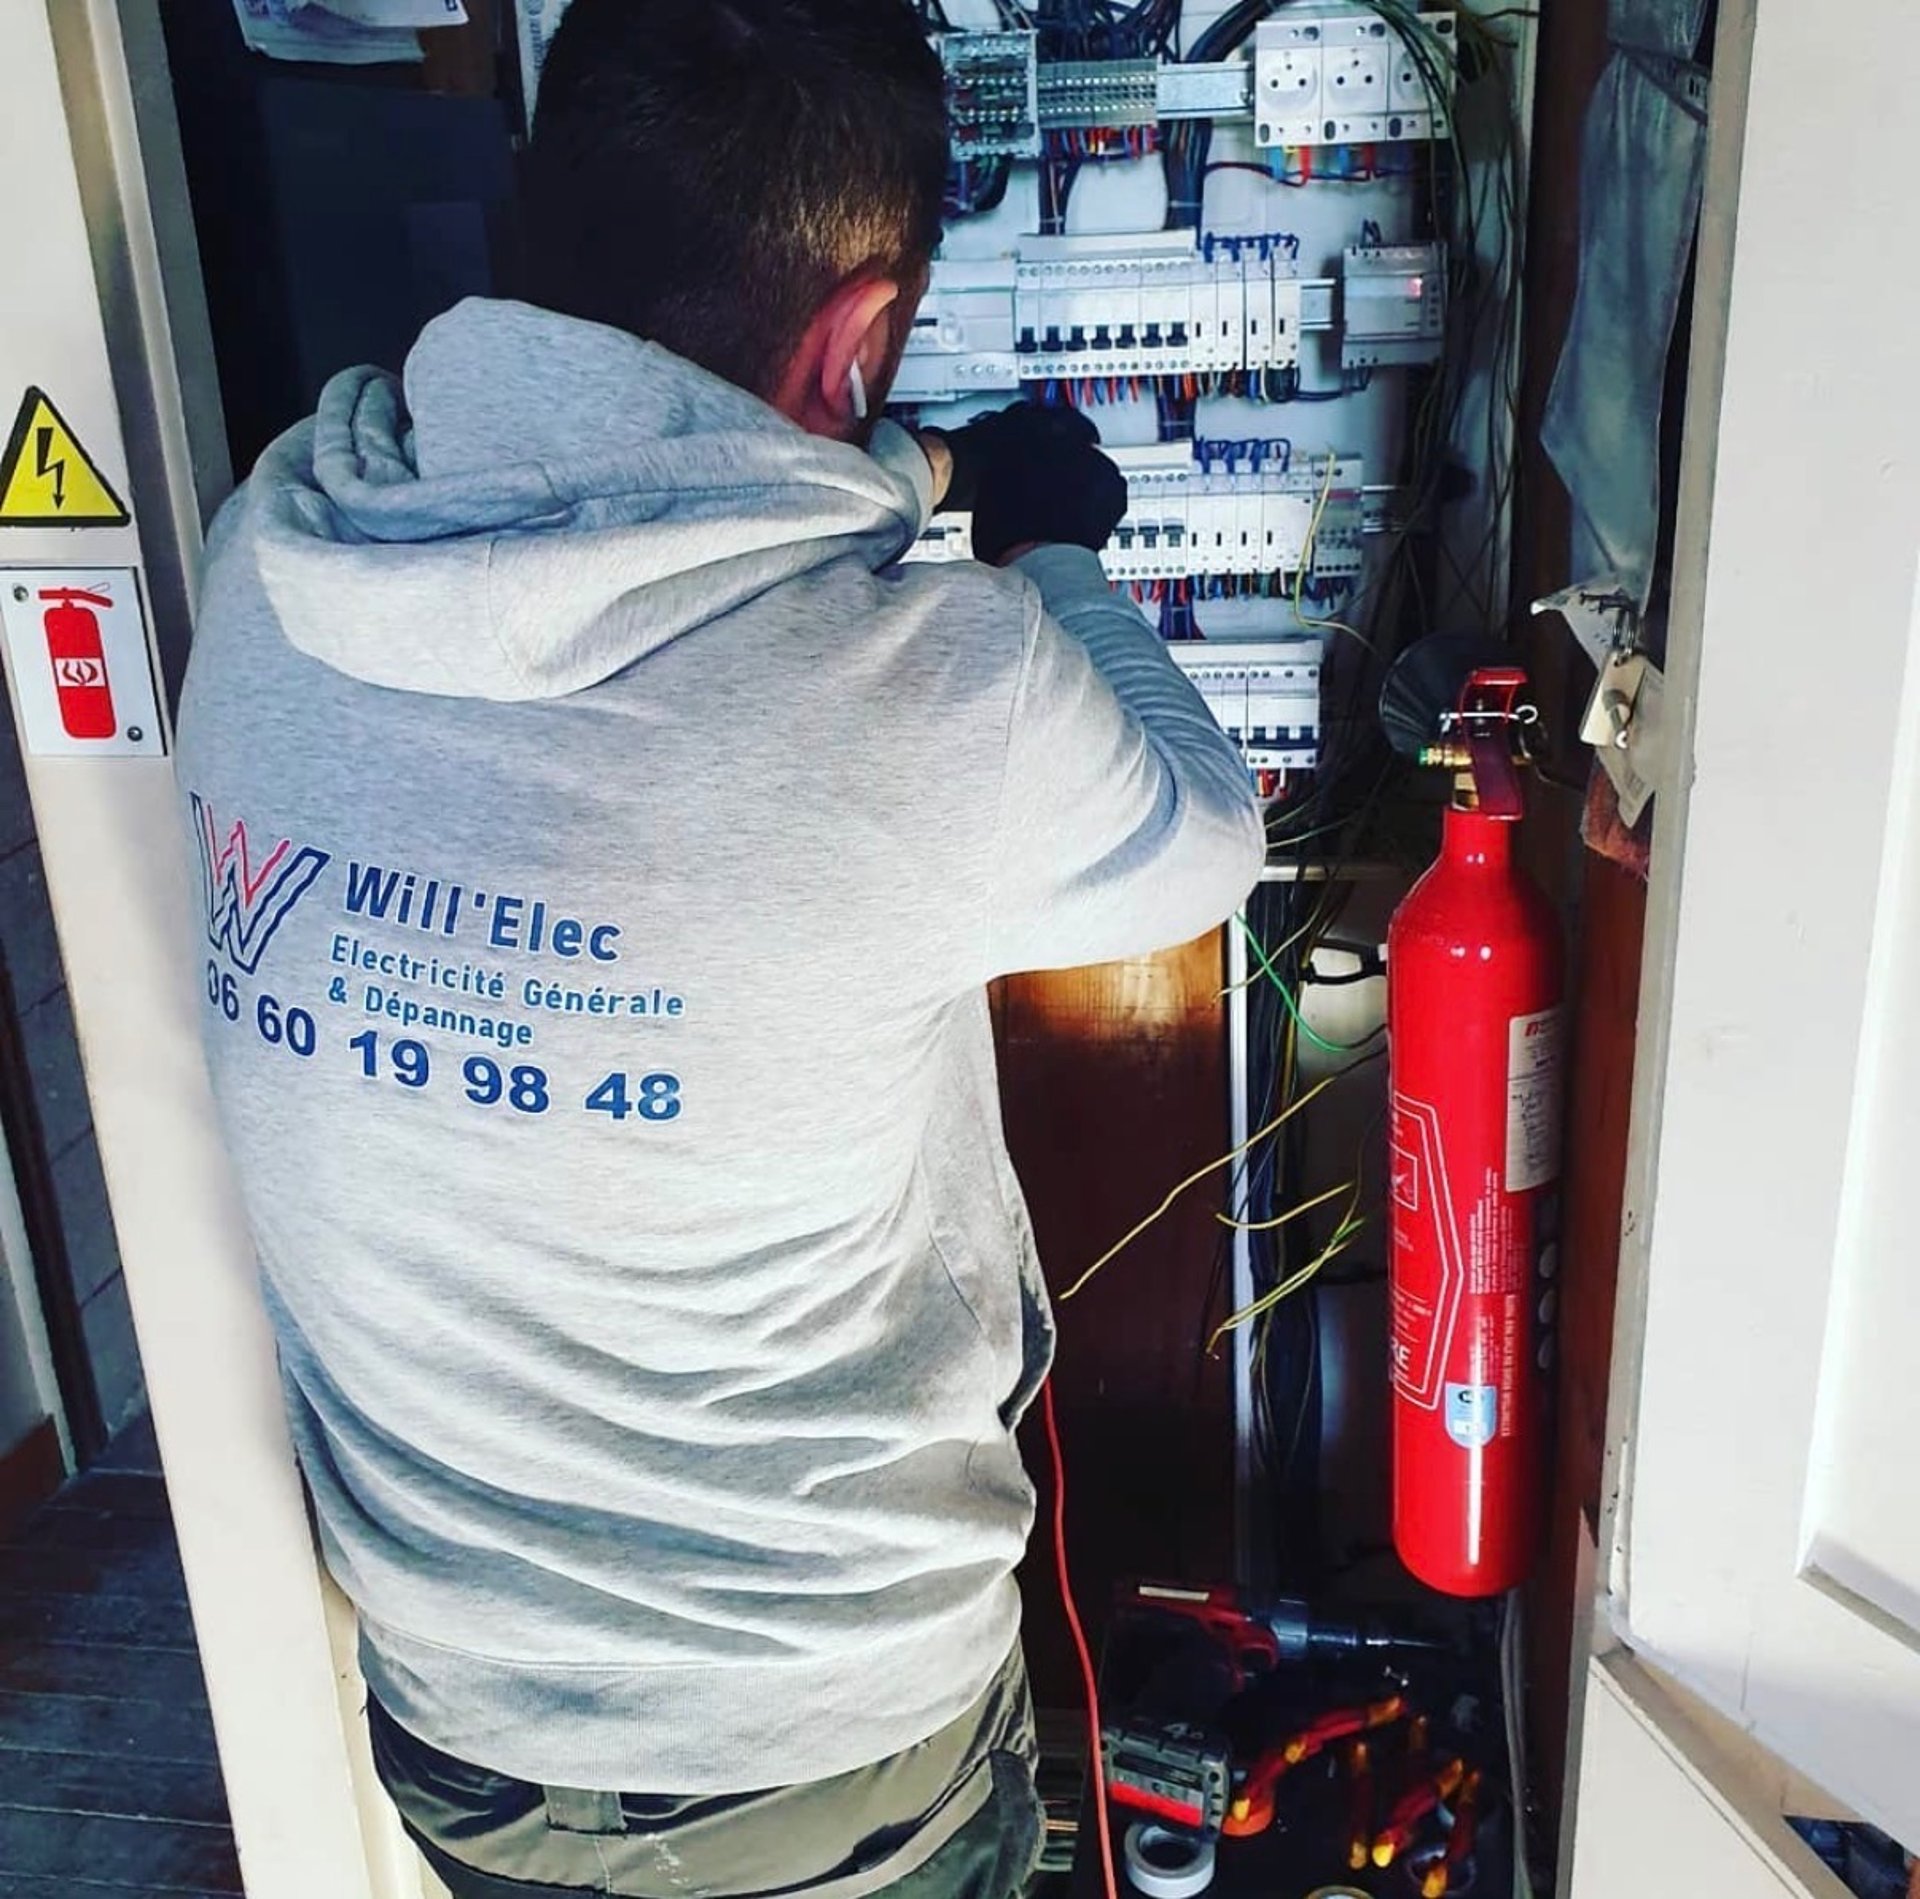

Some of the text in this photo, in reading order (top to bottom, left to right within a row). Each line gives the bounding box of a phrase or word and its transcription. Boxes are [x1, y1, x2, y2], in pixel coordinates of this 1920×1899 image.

[346, 862, 621, 961] Will'Elec
[328, 977, 533, 1047] & Dépannage
[331, 934, 684, 1016] Electricité Générale
[208, 959, 682, 1121] 06 60 19 98 48
